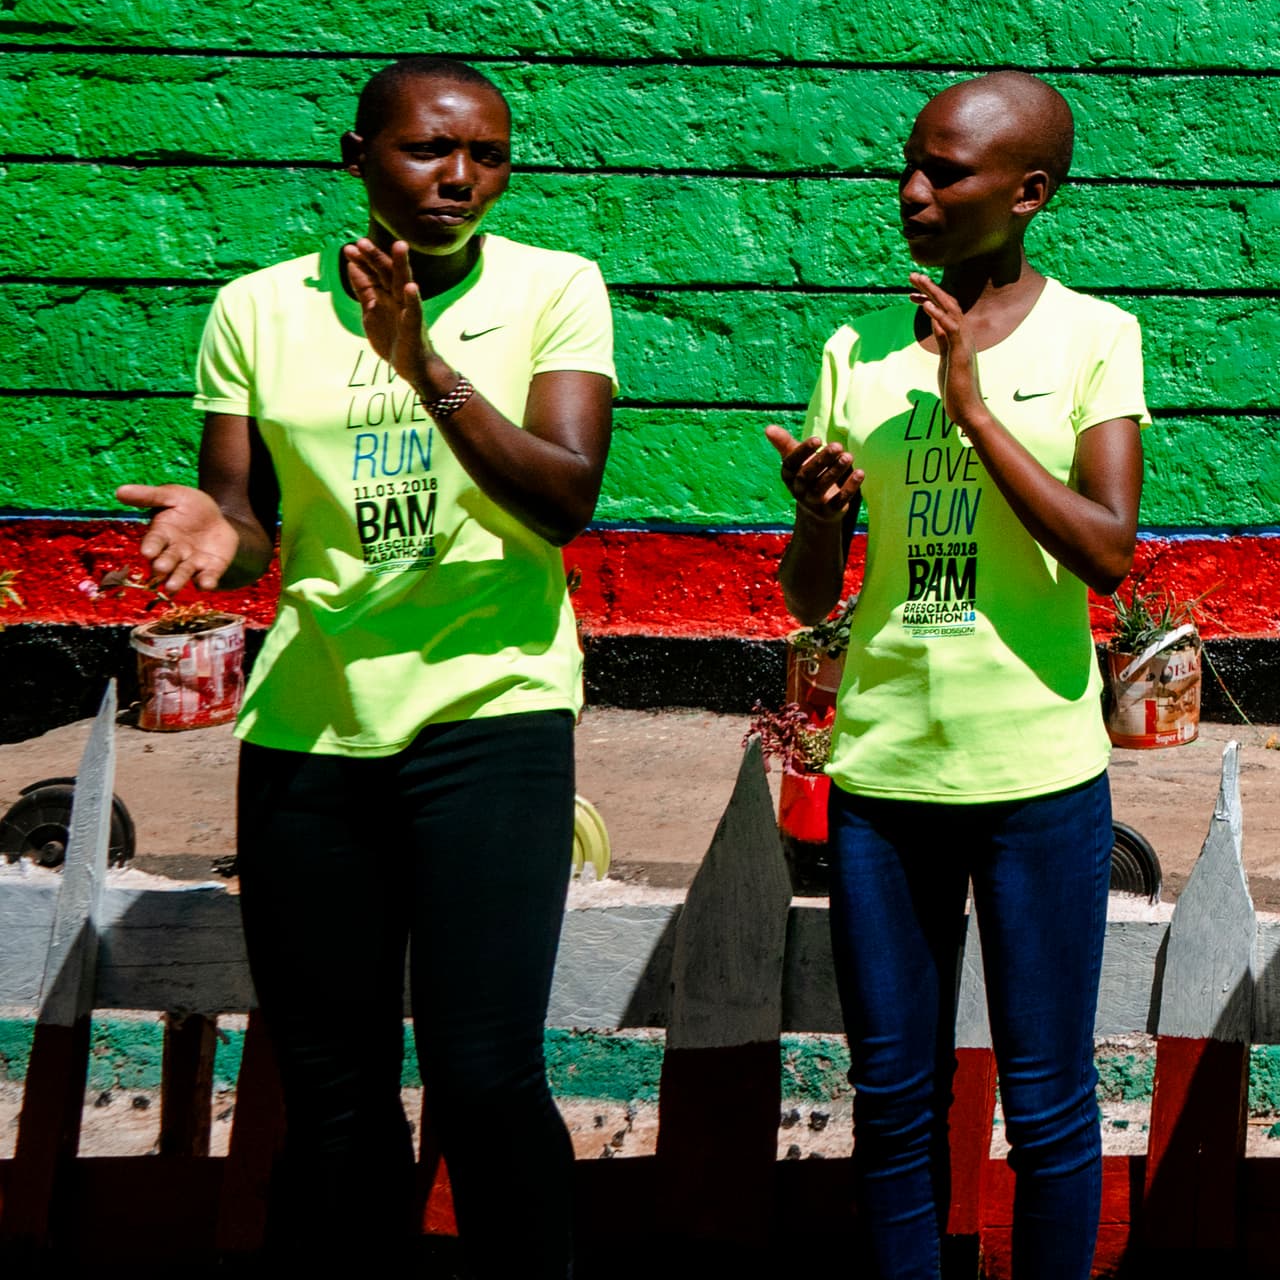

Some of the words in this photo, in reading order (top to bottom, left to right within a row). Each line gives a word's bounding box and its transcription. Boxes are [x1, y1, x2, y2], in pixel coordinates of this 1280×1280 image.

[346, 388, 427, 429] LOVE
[903, 399, 972, 441] LIV
[351, 427, 434, 481] RUN
[904, 446, 980, 486] LOVE
[353, 477, 439, 501] 11.03.2018
[355, 491, 438, 545] BAM
[907, 487, 983, 538] RUN
[907, 541, 978, 558] 11.03.2018
[906, 556, 978, 602] BAM
[903, 602, 950, 615] BRESCIA
[951, 600, 977, 612] ART
